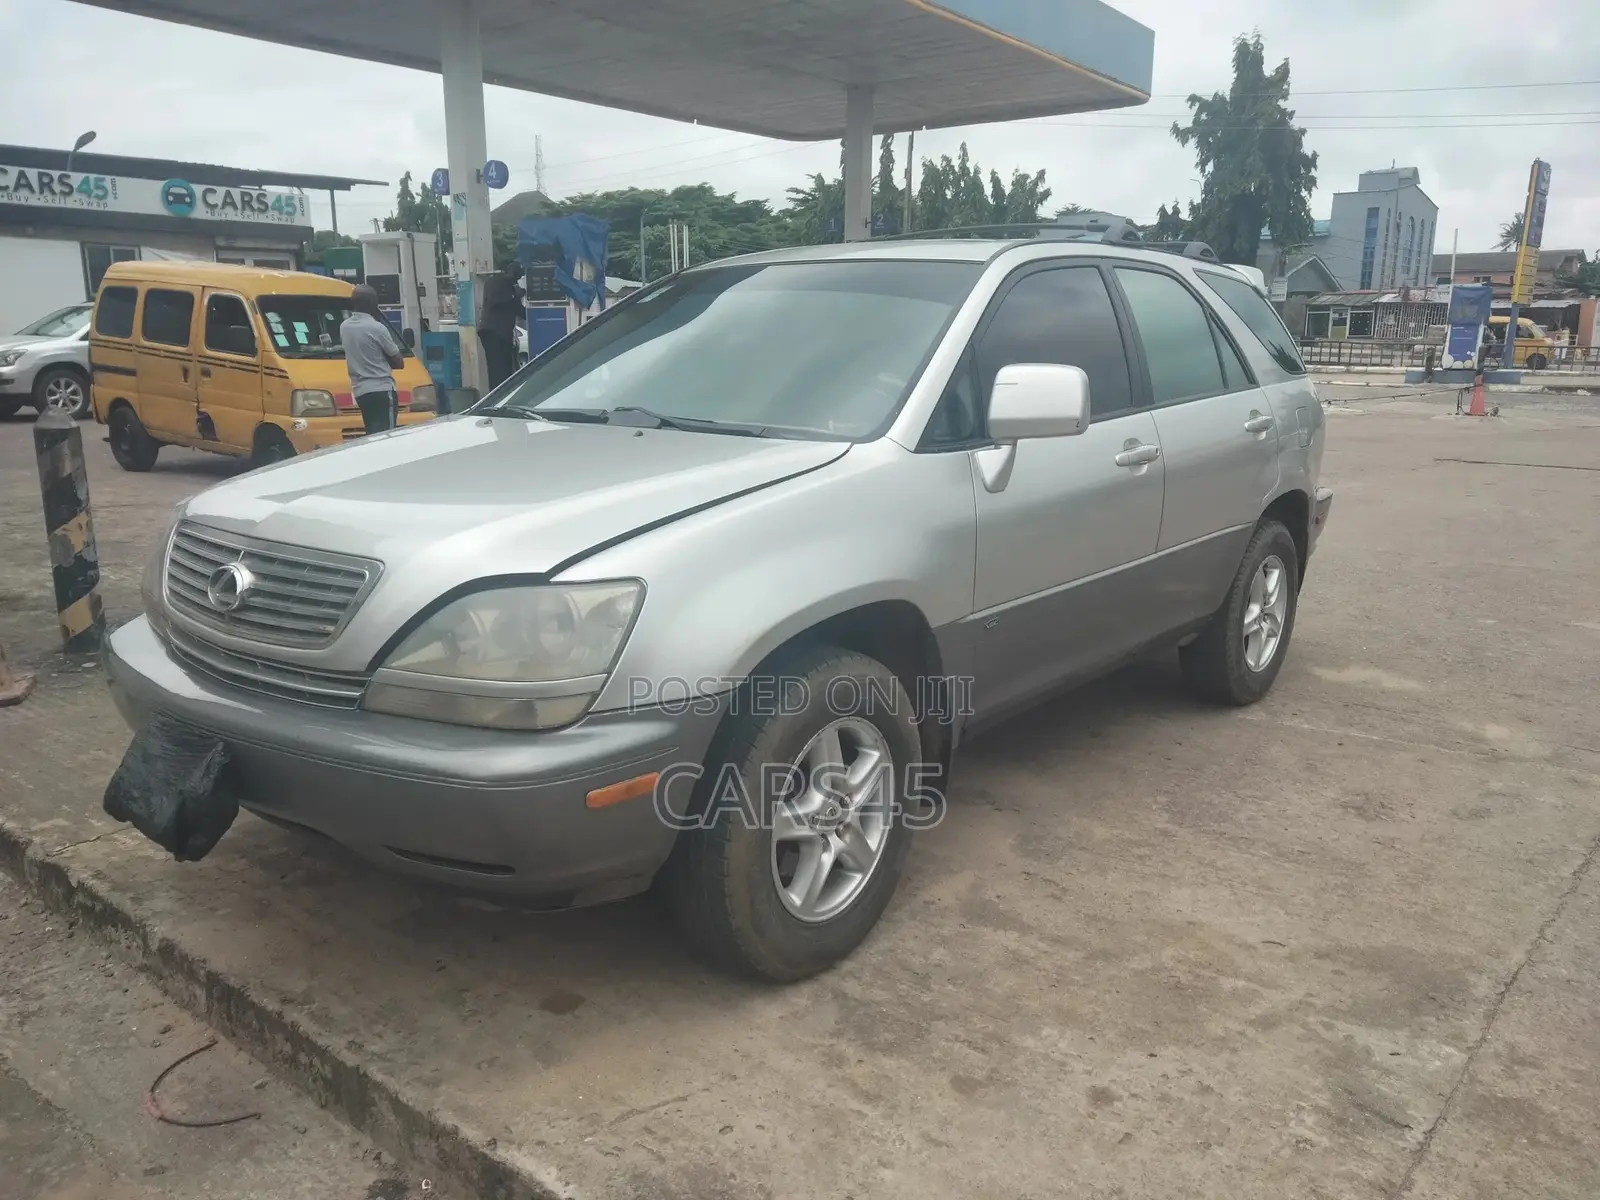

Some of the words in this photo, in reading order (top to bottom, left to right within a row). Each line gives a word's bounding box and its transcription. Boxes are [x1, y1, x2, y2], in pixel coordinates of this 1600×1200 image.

[488, 162, 497, 179] 4
[436, 171, 444, 187] 3
[202, 187, 297, 217] CARS45
[876, 214, 884, 225] 2
